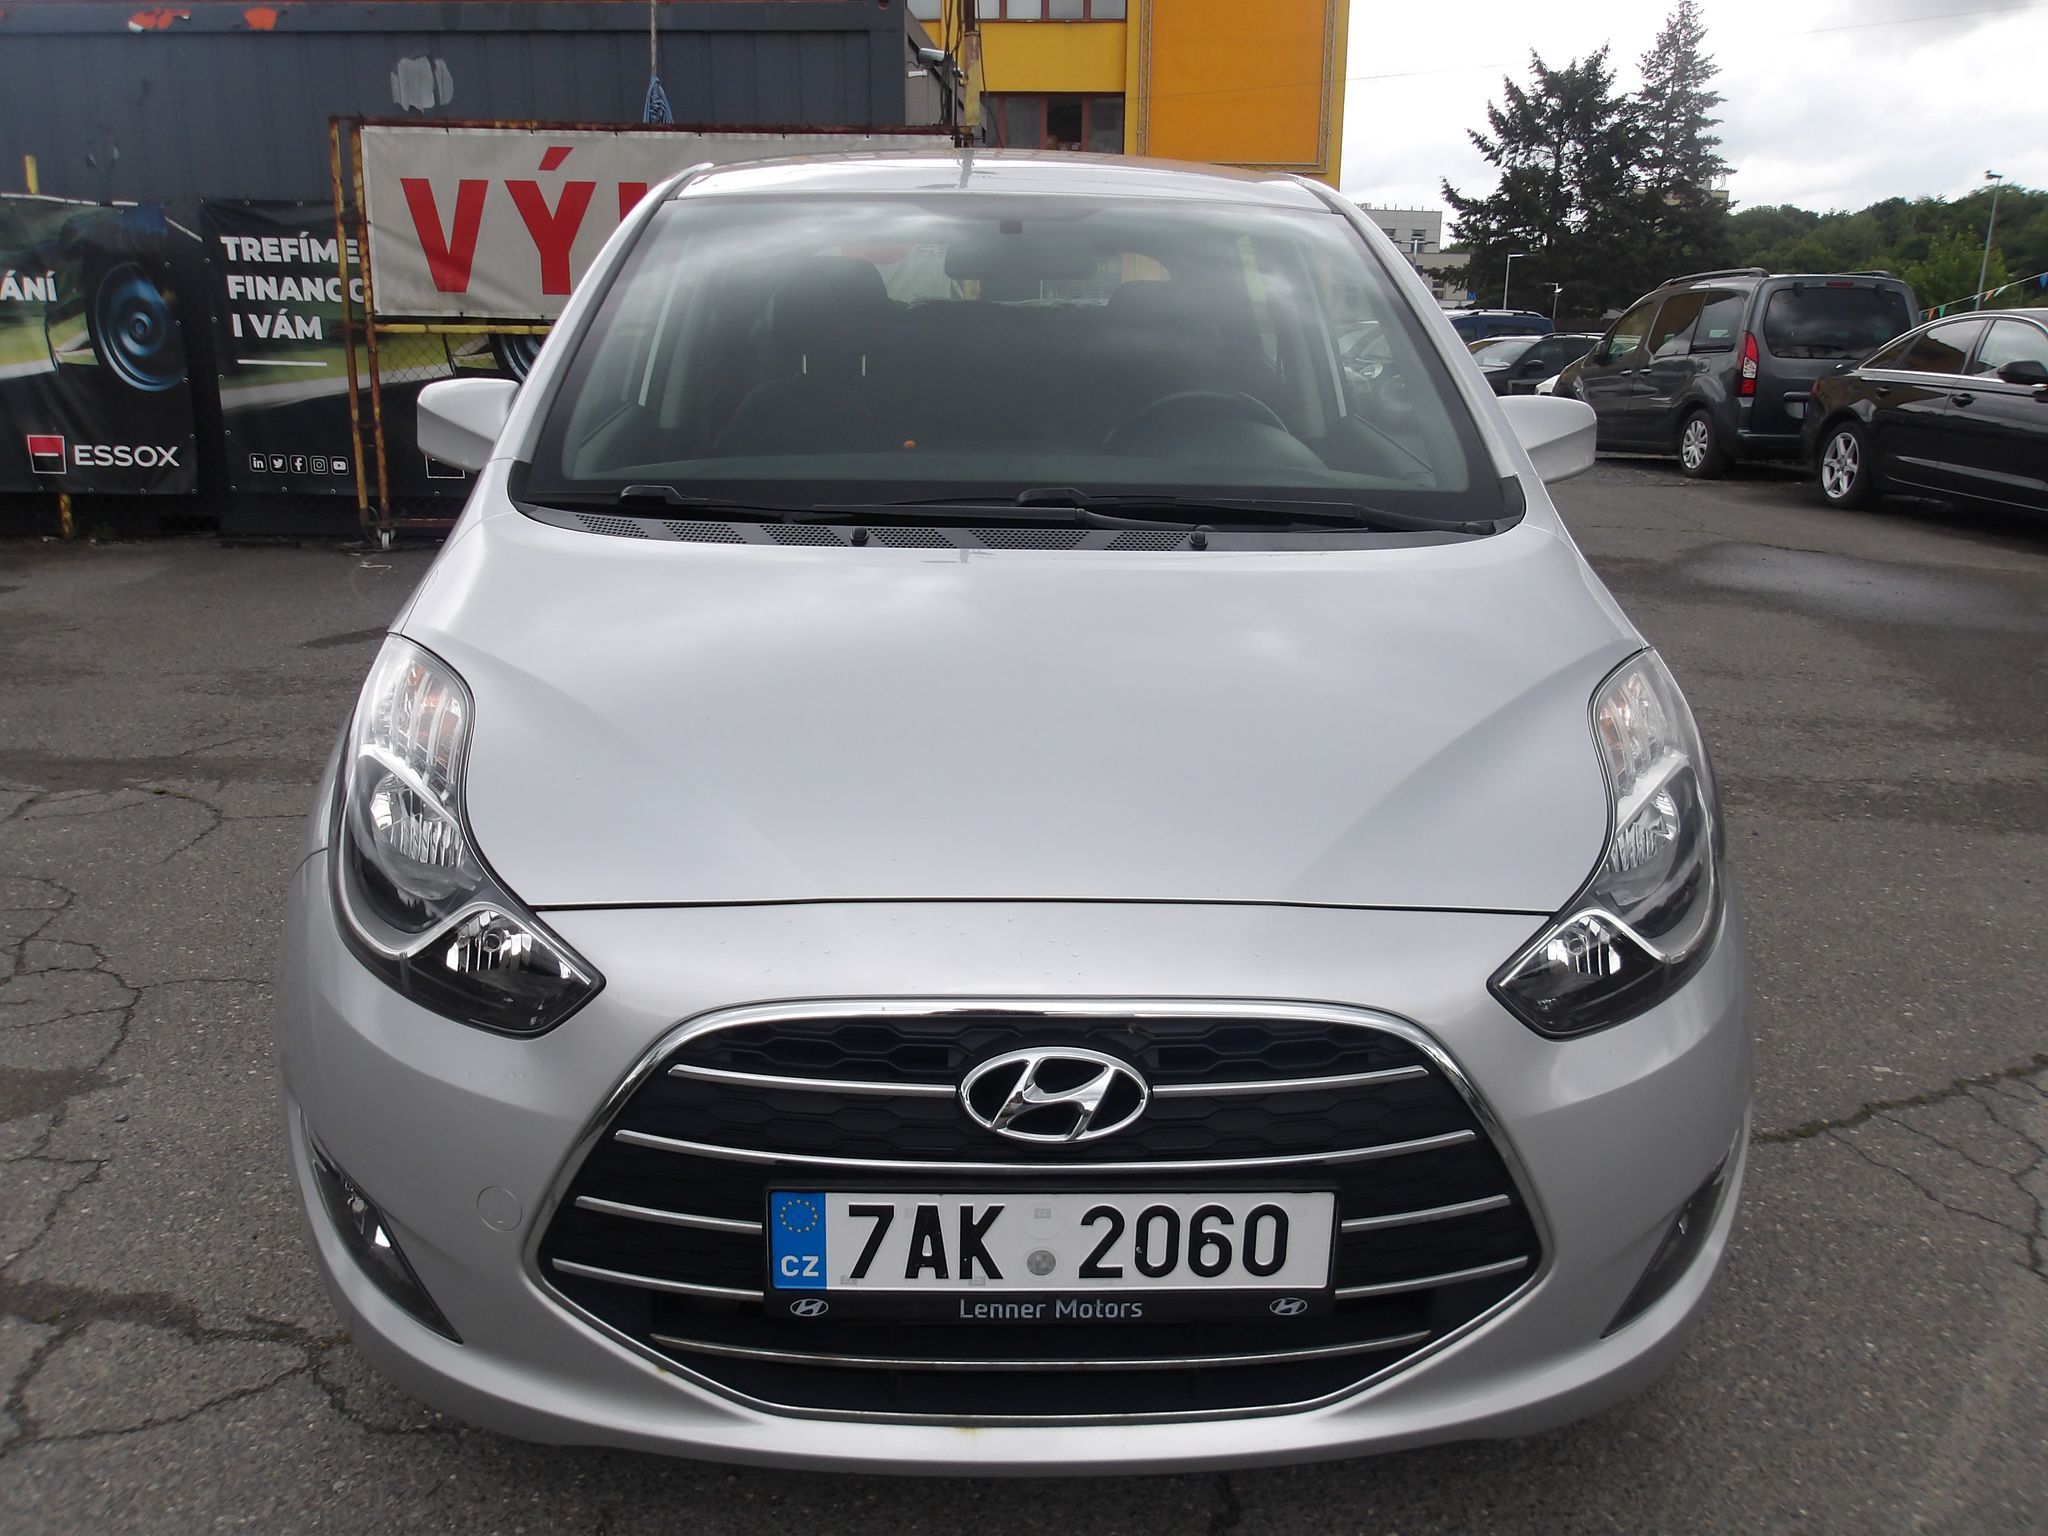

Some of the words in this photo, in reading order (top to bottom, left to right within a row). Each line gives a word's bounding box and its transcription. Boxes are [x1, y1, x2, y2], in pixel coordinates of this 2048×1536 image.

[401, 146, 647, 295] VÝ
[220, 231, 361, 264] TREFÍME
[232, 313, 243, 338] I
[248, 308, 323, 340] VÁM
[74, 444, 180, 468] ESSOX
[848, 1204, 1005, 1280] 7AK
[1078, 1204, 1290, 1279] 2060
[780, 1255, 819, 1277] CZ
[959, 1298, 1045, 1320] Lenner
[1054, 1298, 1143, 1319] Motors
